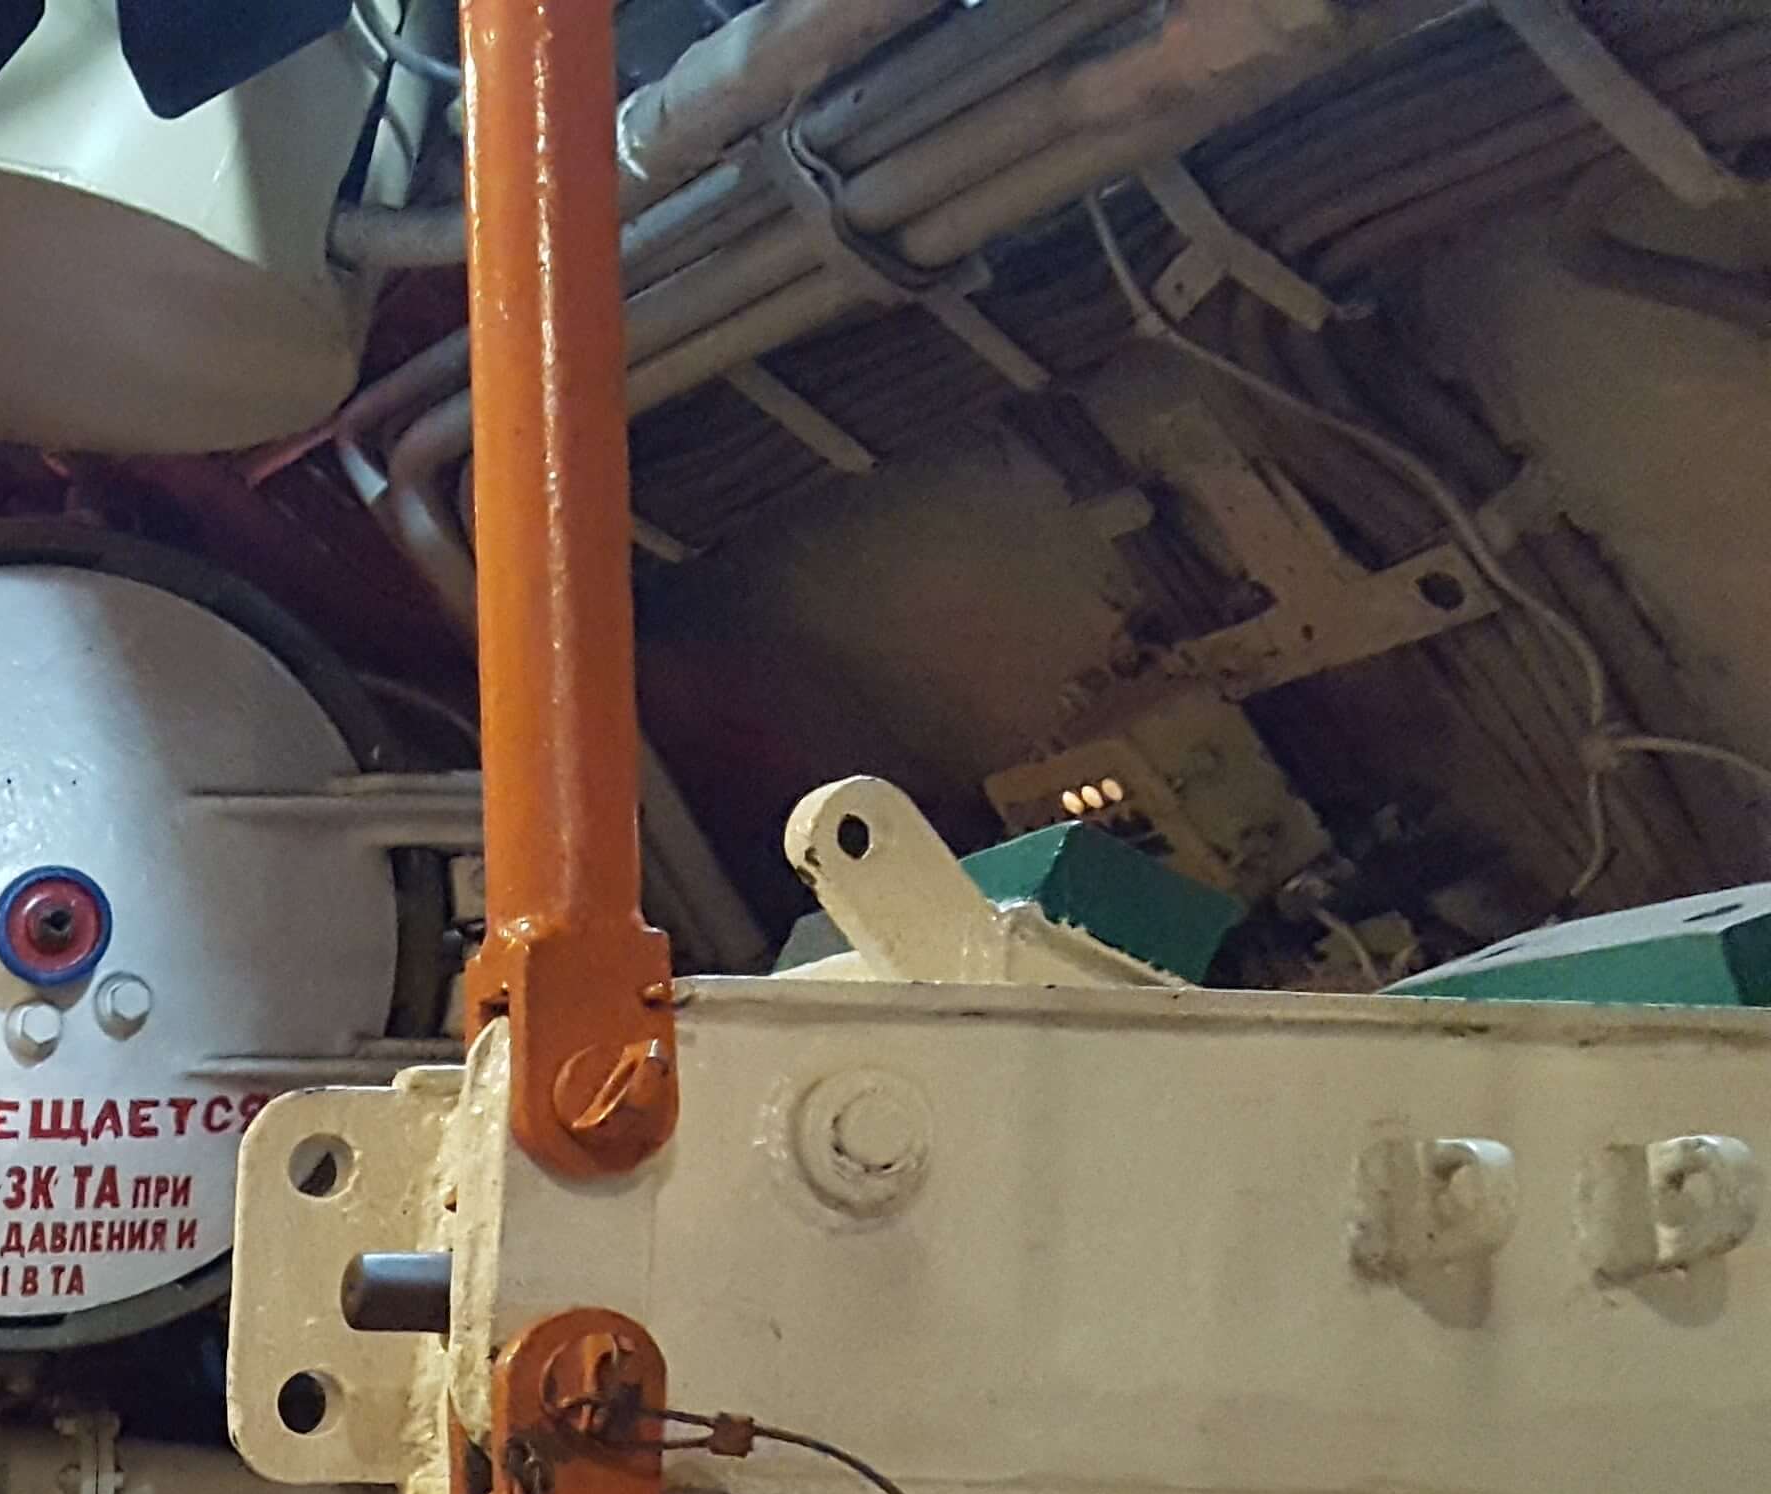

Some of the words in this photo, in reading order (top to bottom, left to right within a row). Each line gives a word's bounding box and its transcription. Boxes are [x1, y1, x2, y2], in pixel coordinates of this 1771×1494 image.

[2, 1166, 57, 1211] ЗК
[73, 1165, 122, 1209] ТА
[131, 1175, 192, 1209] ПРИ
[0, 1219, 168, 1258] ДАВЛЕНИЯ
[175, 1218, 198, 1250] И
[20, 1266, 39, 1296] В
[49, 1264, 85, 1296] ТА
